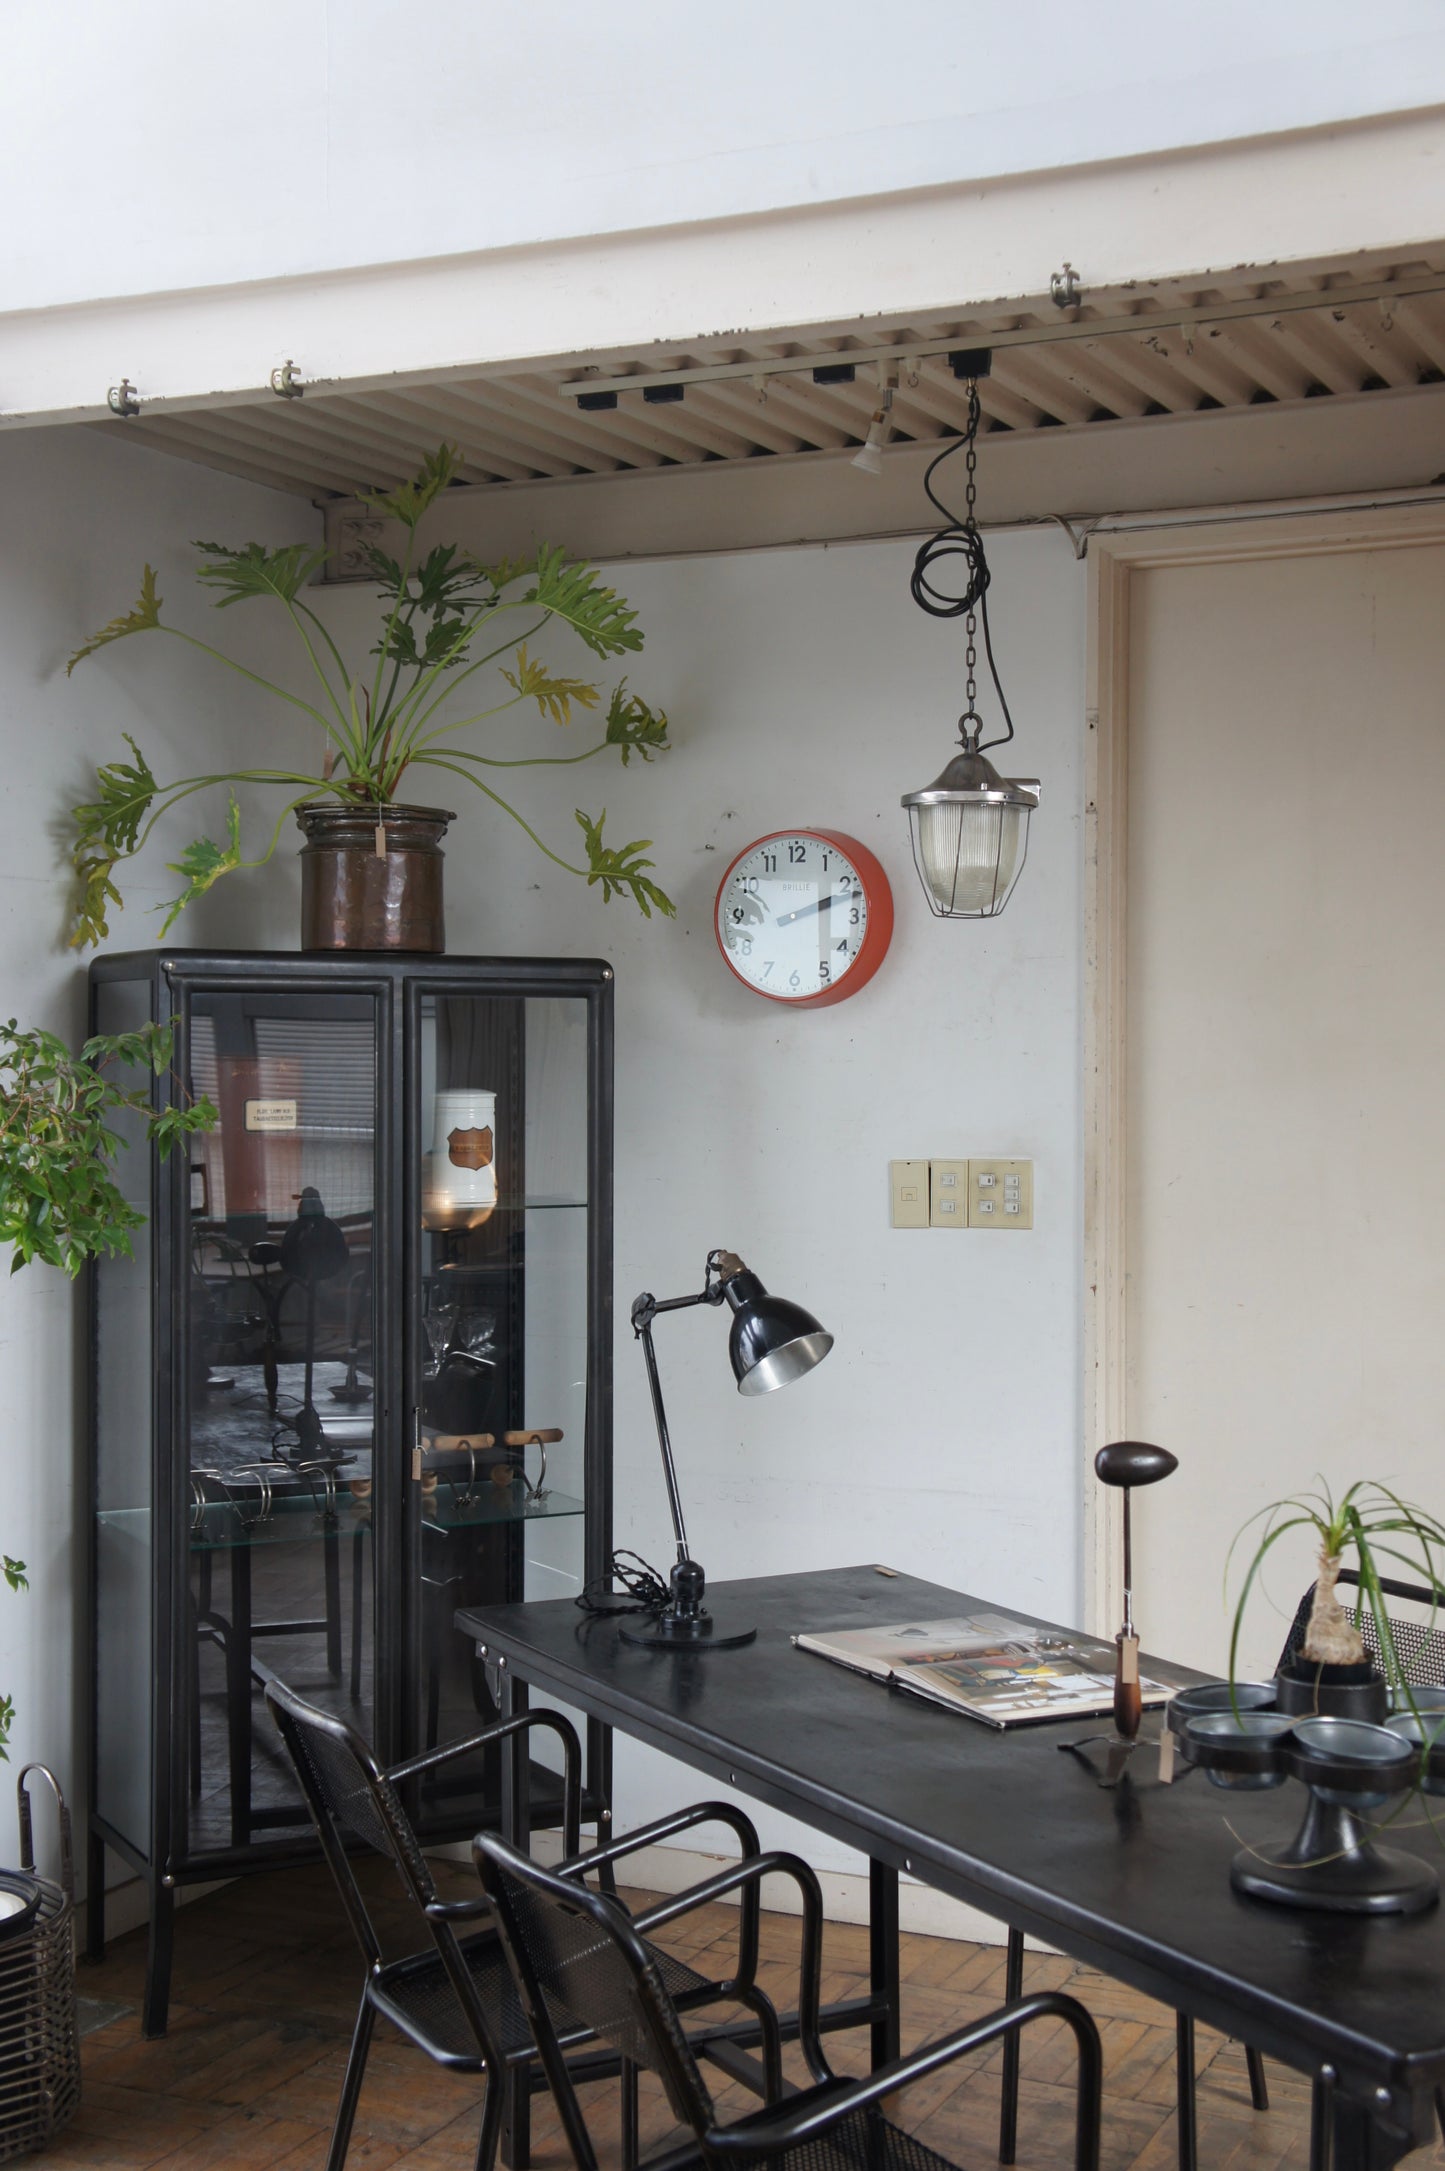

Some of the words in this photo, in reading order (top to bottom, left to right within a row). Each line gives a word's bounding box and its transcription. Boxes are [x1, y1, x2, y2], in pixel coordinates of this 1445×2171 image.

[788, 846, 806, 863] 12
[822, 854, 828, 871] 1
[764, 855, 777, 872] 11
[742, 877, 759, 892] 10
[839, 876, 851, 893] 2
[733, 908, 744, 924] 9
[849, 908, 859, 924] 3
[741, 939, 752, 956] 8
[837, 939, 848, 956] 4
[764, 961, 775, 977] 7
[789, 969, 800, 986] 6
[819, 961, 829, 977] 5
